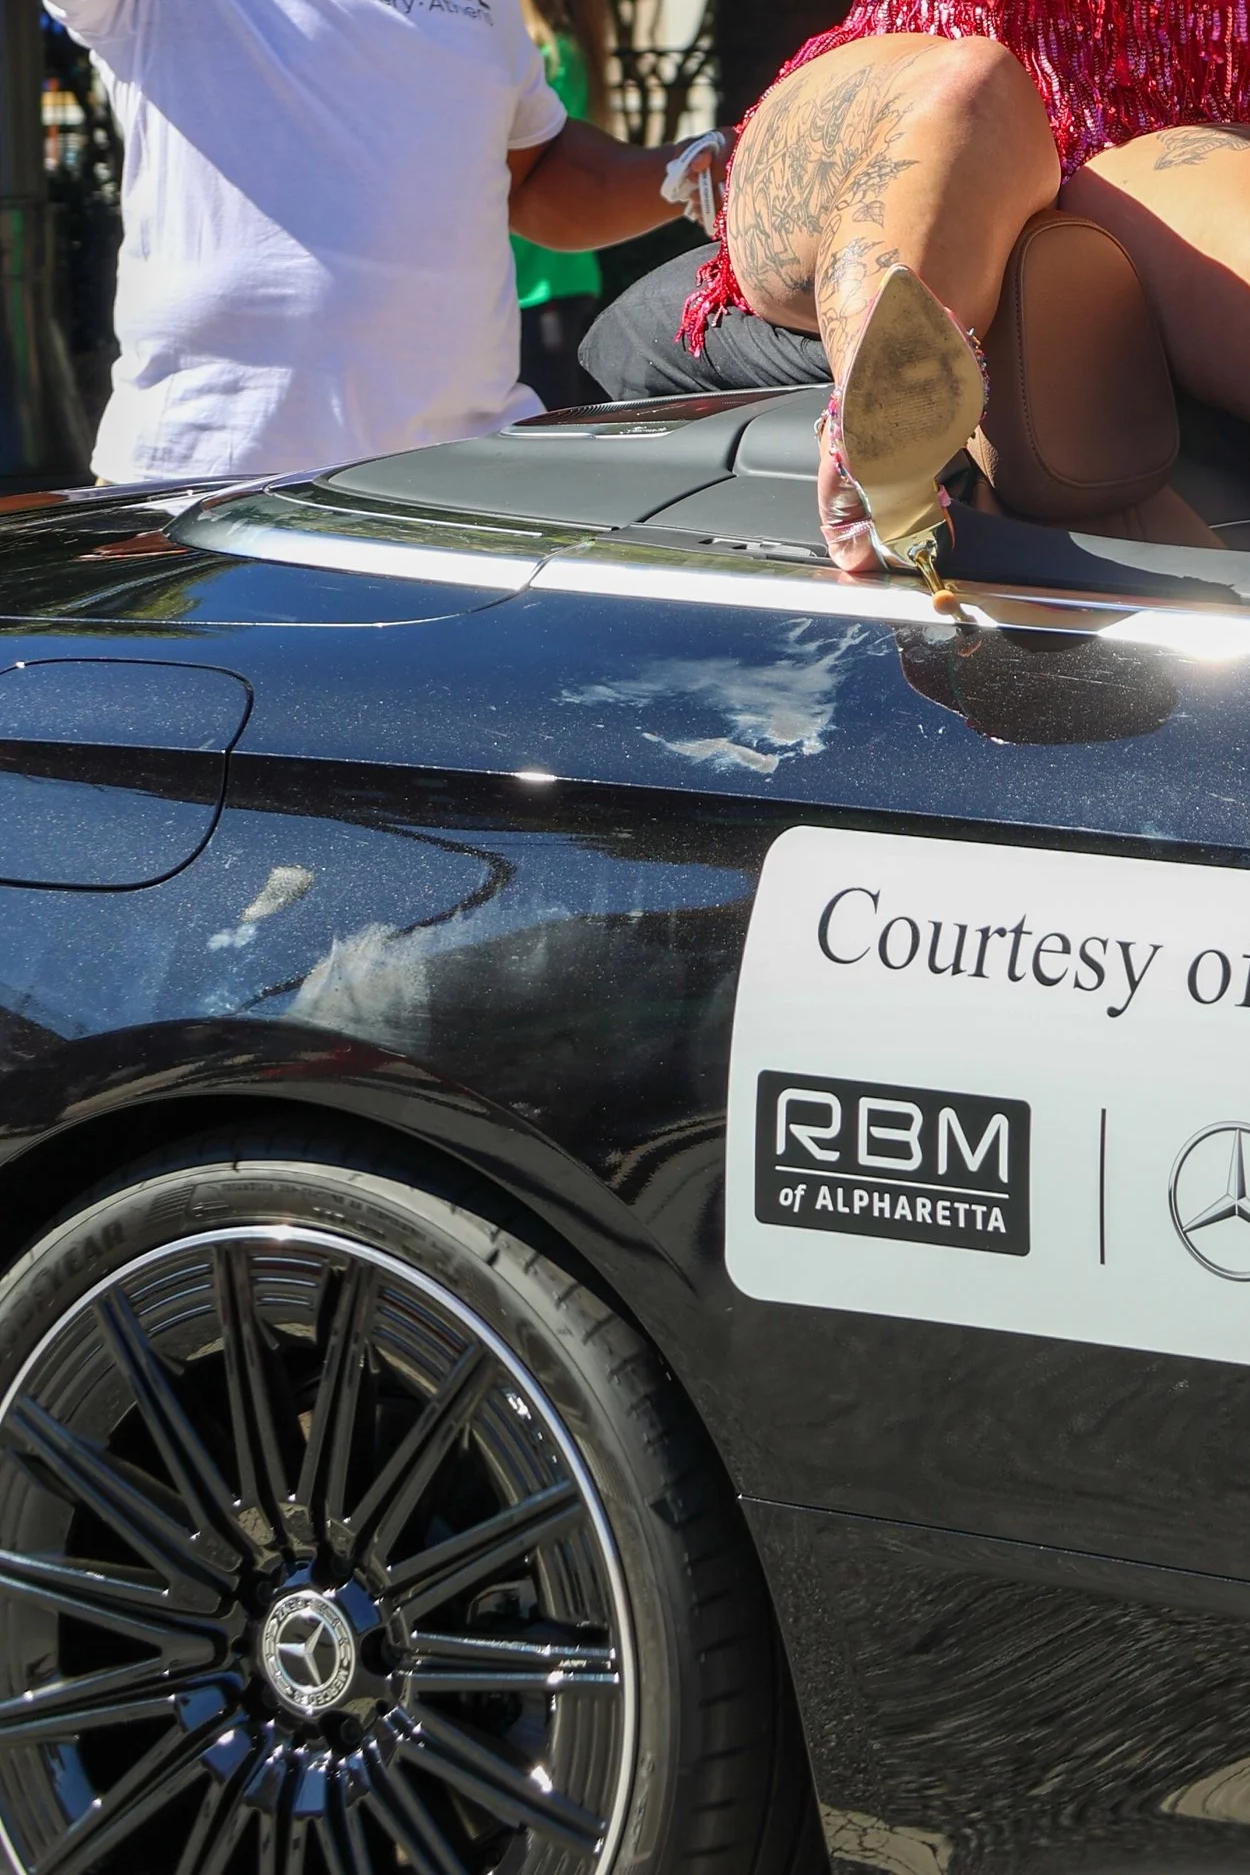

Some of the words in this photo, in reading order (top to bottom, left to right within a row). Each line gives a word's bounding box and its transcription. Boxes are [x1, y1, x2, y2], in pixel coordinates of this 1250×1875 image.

[817, 887, 1164, 1019] Courtesy
[776, 1088, 1010, 1184] RBM
[778, 1184, 807, 1213] of
[815, 1185, 1007, 1234] ALPHARETTA
